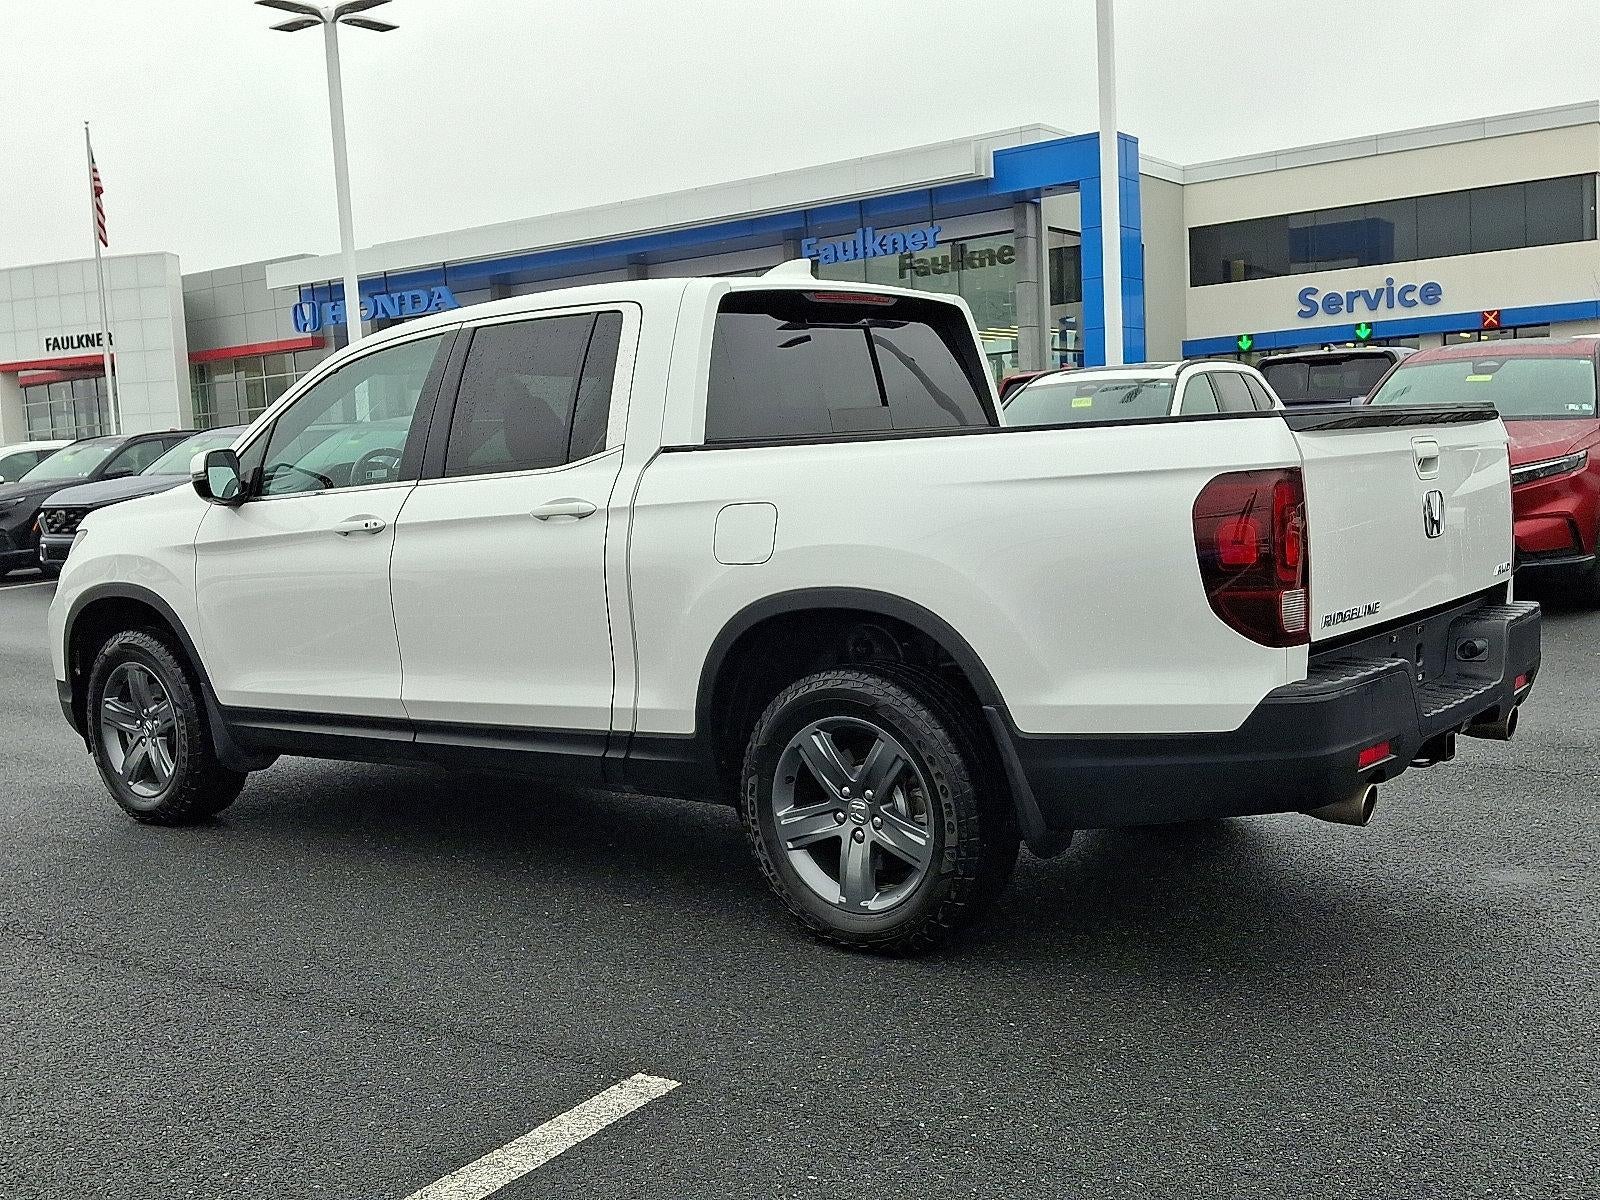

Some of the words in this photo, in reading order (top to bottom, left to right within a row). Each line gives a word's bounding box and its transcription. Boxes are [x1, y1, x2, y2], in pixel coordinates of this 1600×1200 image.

[801, 225, 942, 265] Faulkner
[321, 285, 460, 326] HONDA
[1297, 277, 1442, 318] Service
[1321, 600, 1381, 629] RIDGELINE
